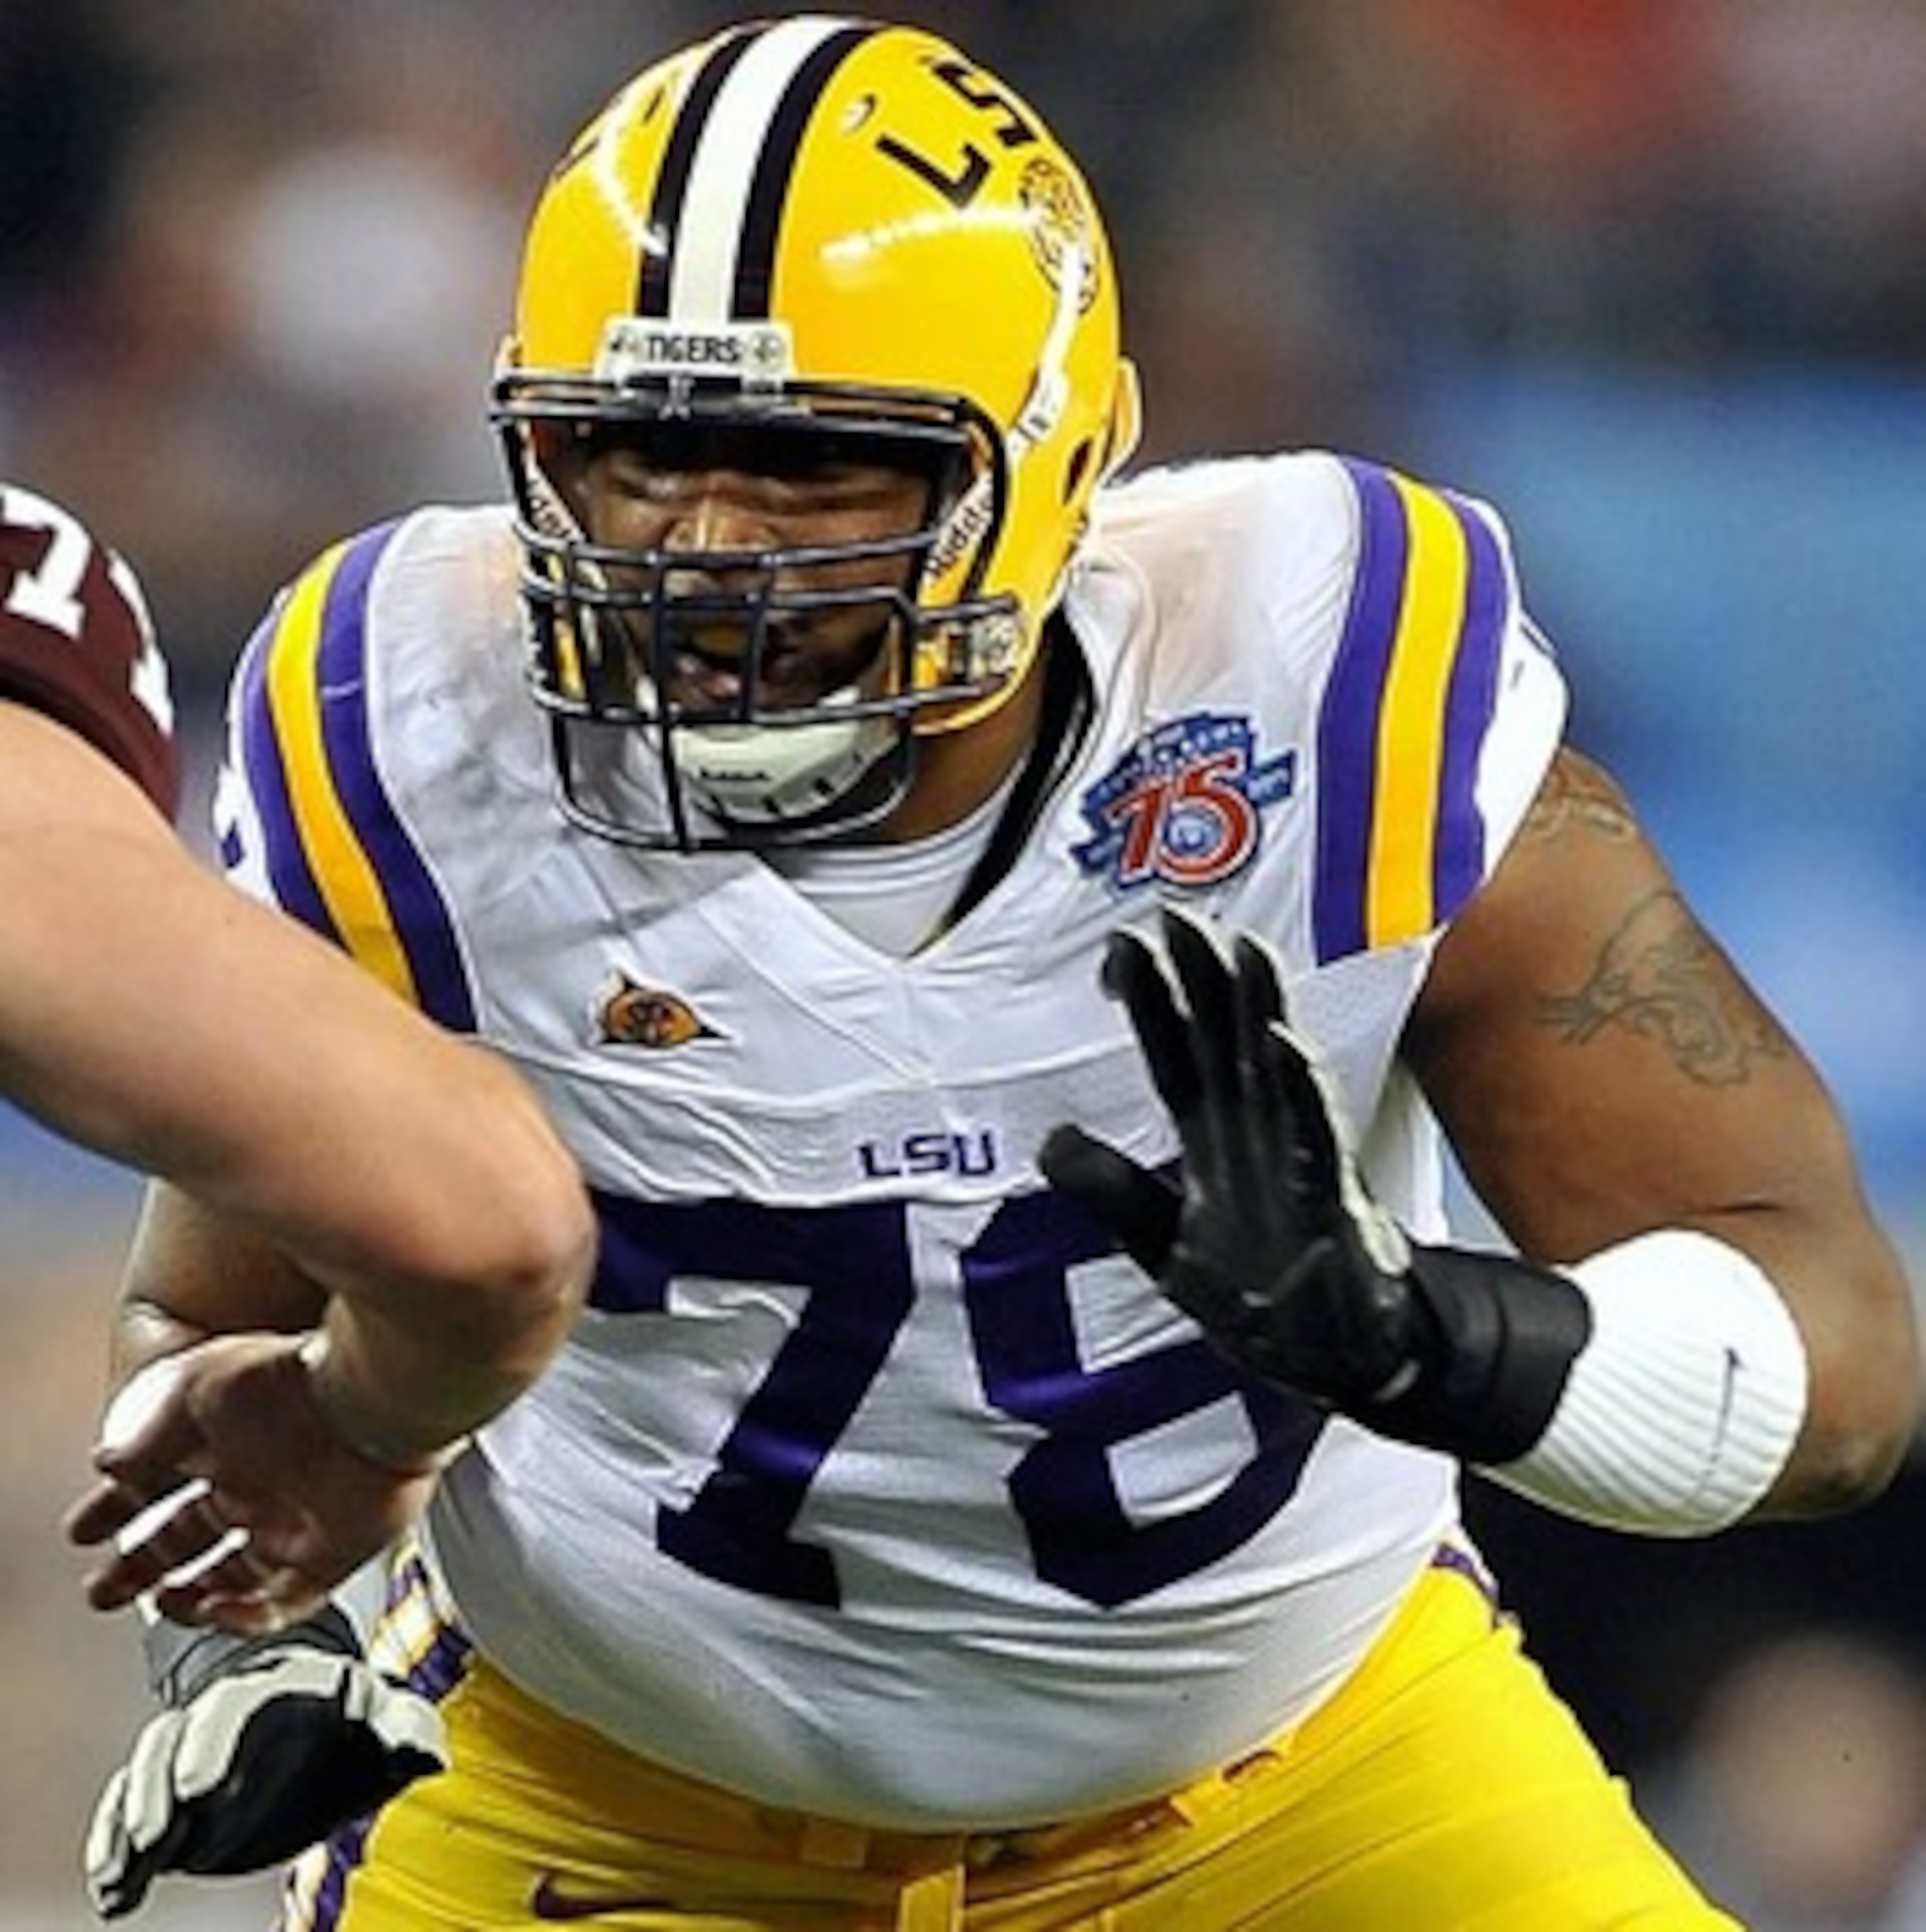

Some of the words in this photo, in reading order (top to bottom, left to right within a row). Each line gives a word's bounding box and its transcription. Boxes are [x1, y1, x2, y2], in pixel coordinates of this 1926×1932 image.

[647, 335, 740, 362] TIGERS
[858, 1131, 995, 1178] LSU
[587, 1163, 1334, 1611] 78
